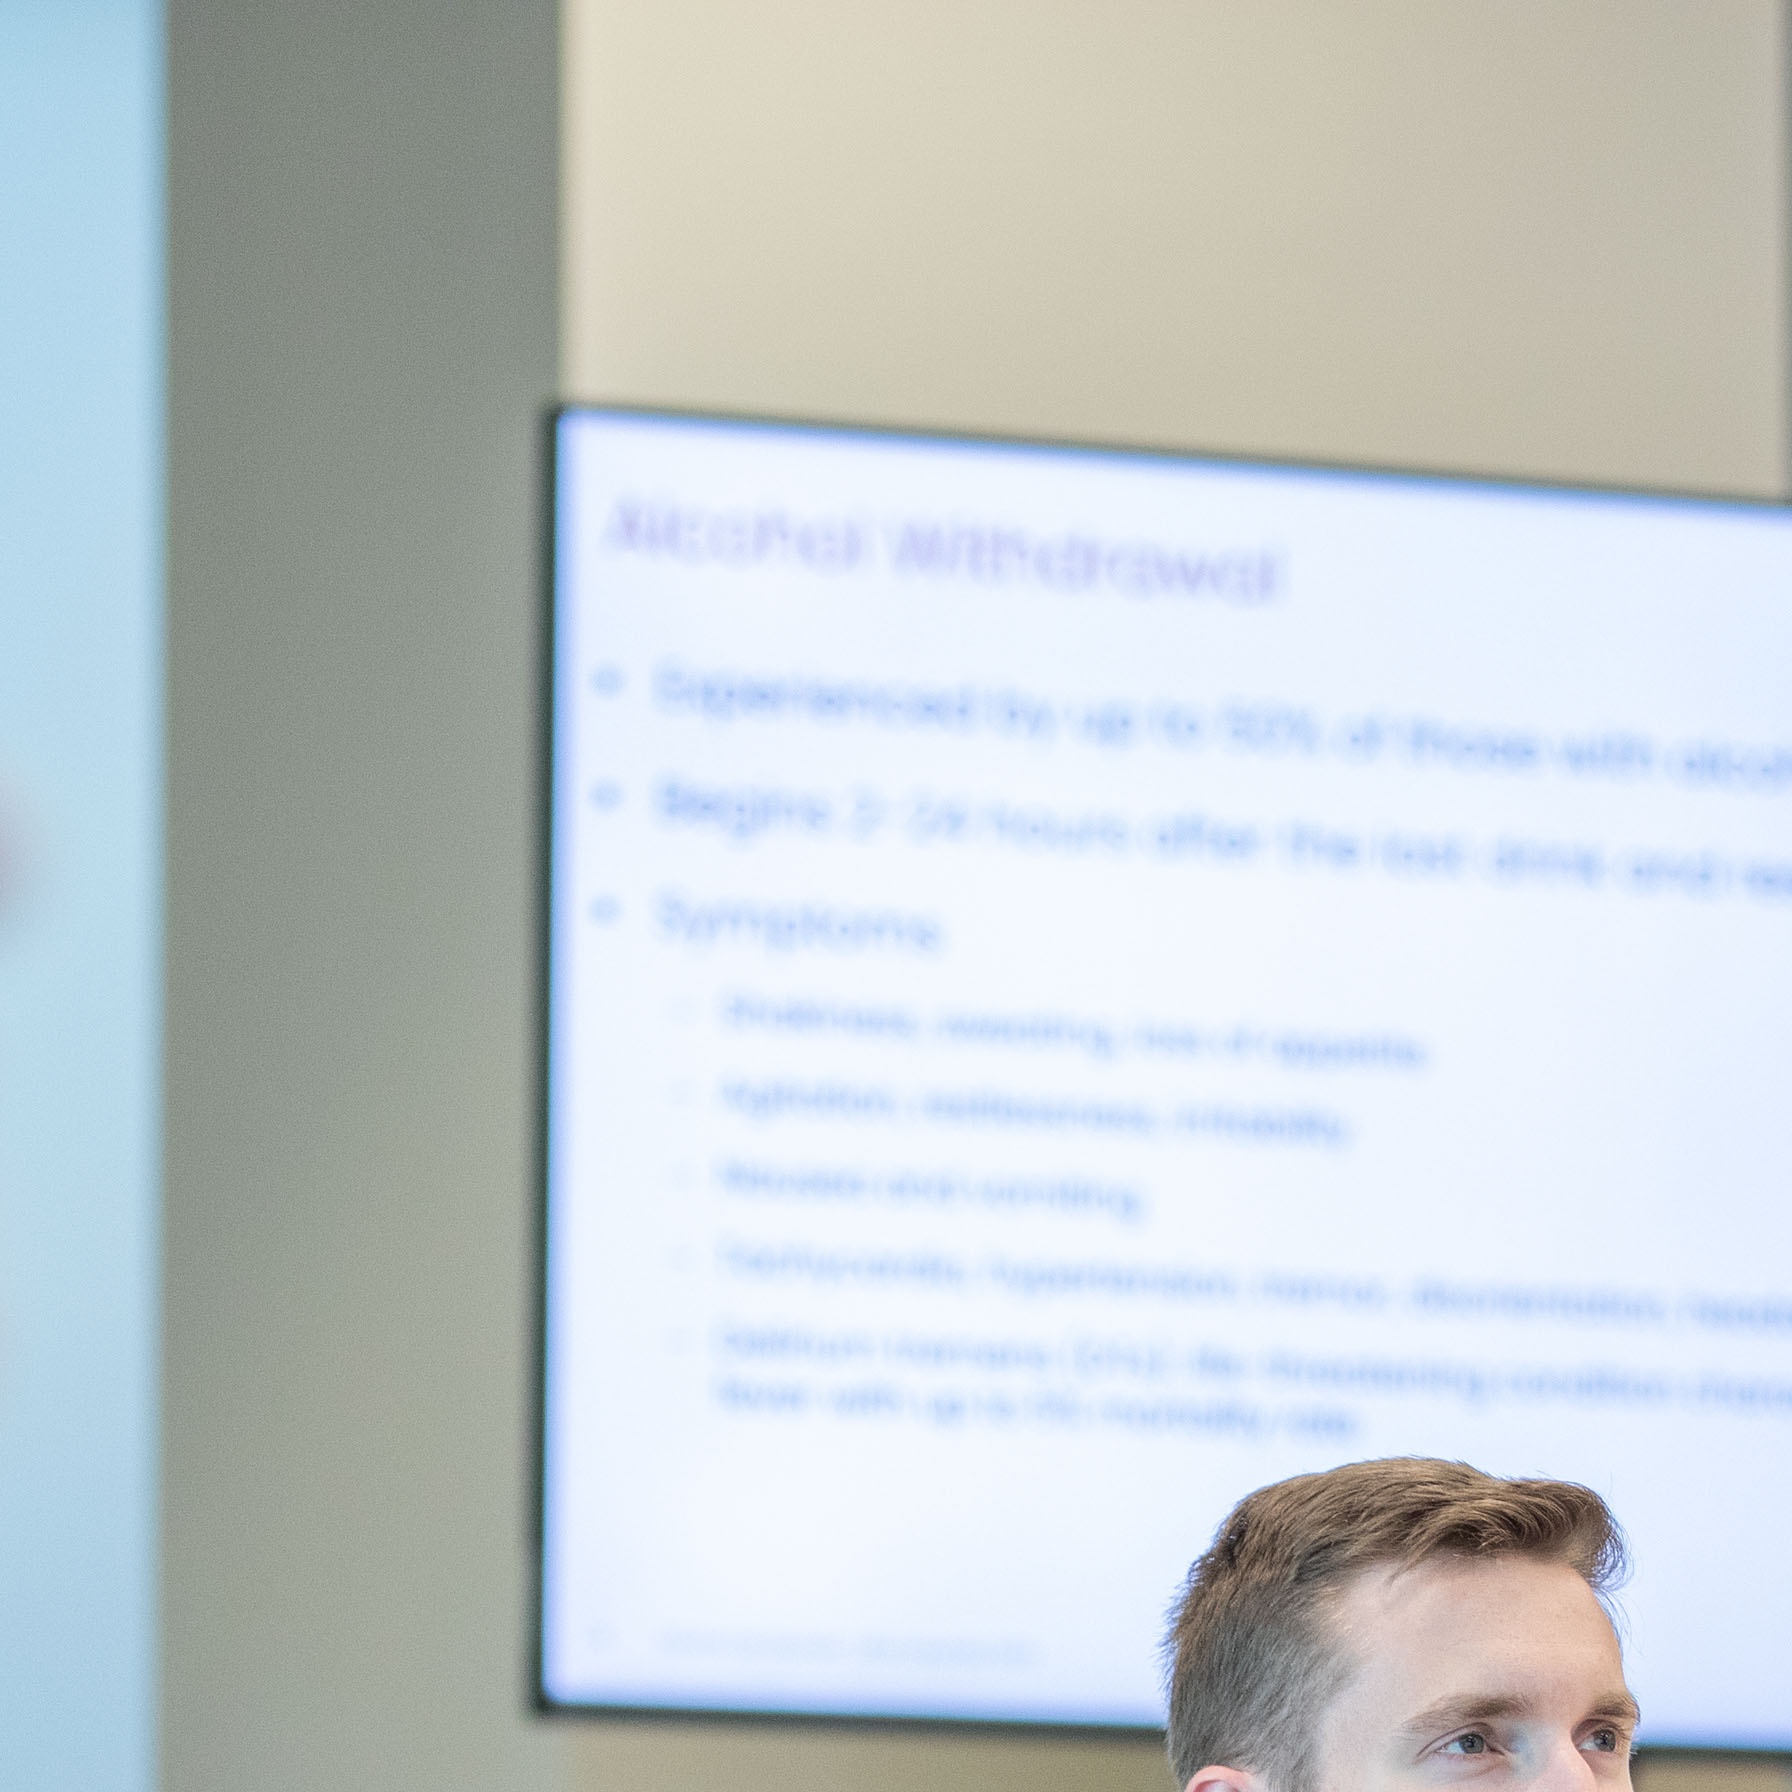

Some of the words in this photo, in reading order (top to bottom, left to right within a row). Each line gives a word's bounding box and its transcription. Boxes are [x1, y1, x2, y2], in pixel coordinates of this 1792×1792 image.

[607, 488, 872, 576] Alcohol
[888, 509, 1286, 606] Withdrawal
[659, 655, 983, 748] Experienced
[992, 679, 1066, 755] by
[1070, 695, 1144, 760] up
[1153, 690, 1212, 752] to
[1333, 703, 1394, 765] of
[1390, 708, 1549, 776] those
[1554, 720, 1664, 784] with
[655, 771, 837, 855] Begins
[981, 794, 1134, 861] hours
[1142, 805, 1271, 871] after
[1278, 814, 1372, 878] the
[1375, 821, 1473, 884] last
[1479, 828, 1609, 894] drink
[1617, 837, 1726, 901] and
[657, 887, 947, 970] Symptoms
